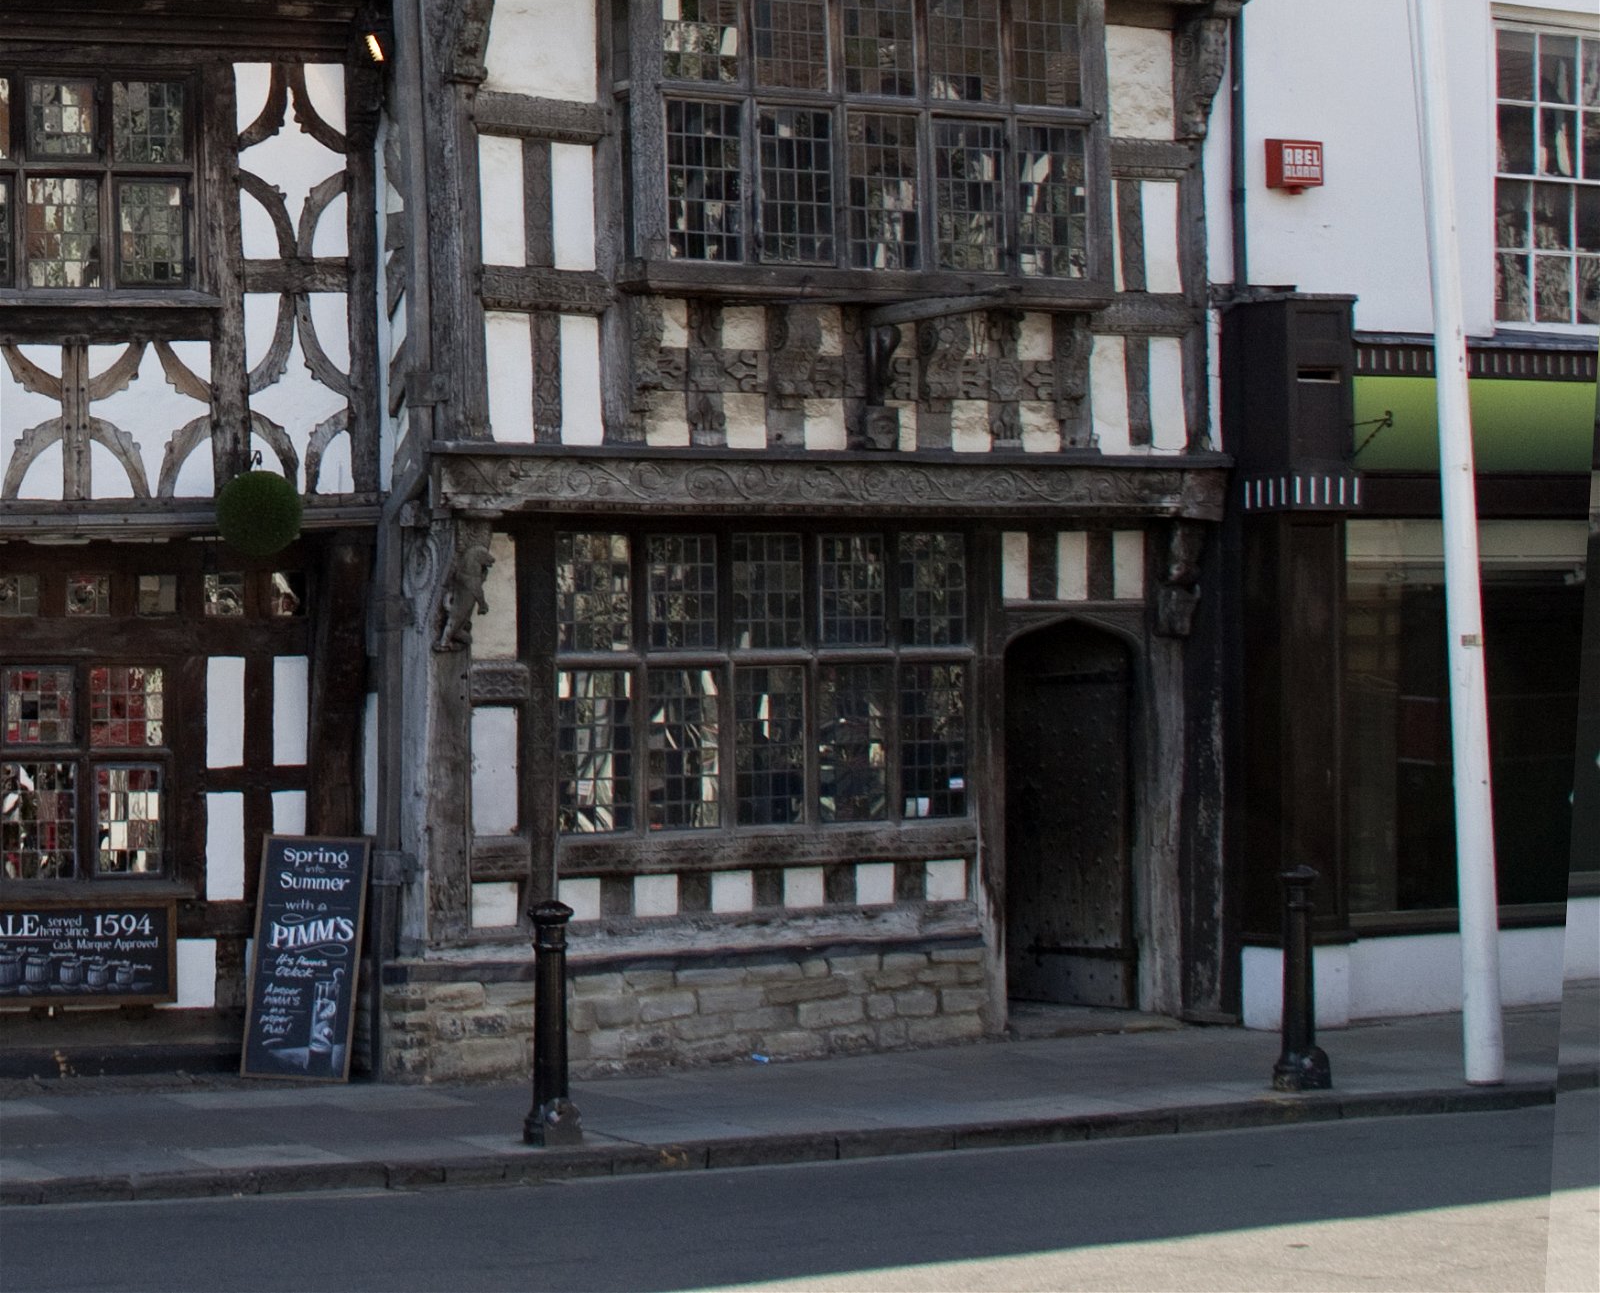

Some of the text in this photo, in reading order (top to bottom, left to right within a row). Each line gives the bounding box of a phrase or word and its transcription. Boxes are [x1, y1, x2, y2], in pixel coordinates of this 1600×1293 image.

[1284, 148, 1320, 165] ABEL
[1284, 165, 1320, 178] ALARM
[283, 847, 350, 869] Spring
[280, 871, 351, 891] Summer
[285, 898, 314, 911] with
[0, 914, 40, 937] LE
[47, 915, 82, 927] served
[94, 913, 153, 937] 1594
[40, 925, 90, 937] here since
[270, 916, 354, 948] PIMM'S
[53, 938, 74, 950] Cask
[76, 938, 112, 952] Marque
[114, 936, 159, 951] Approved
